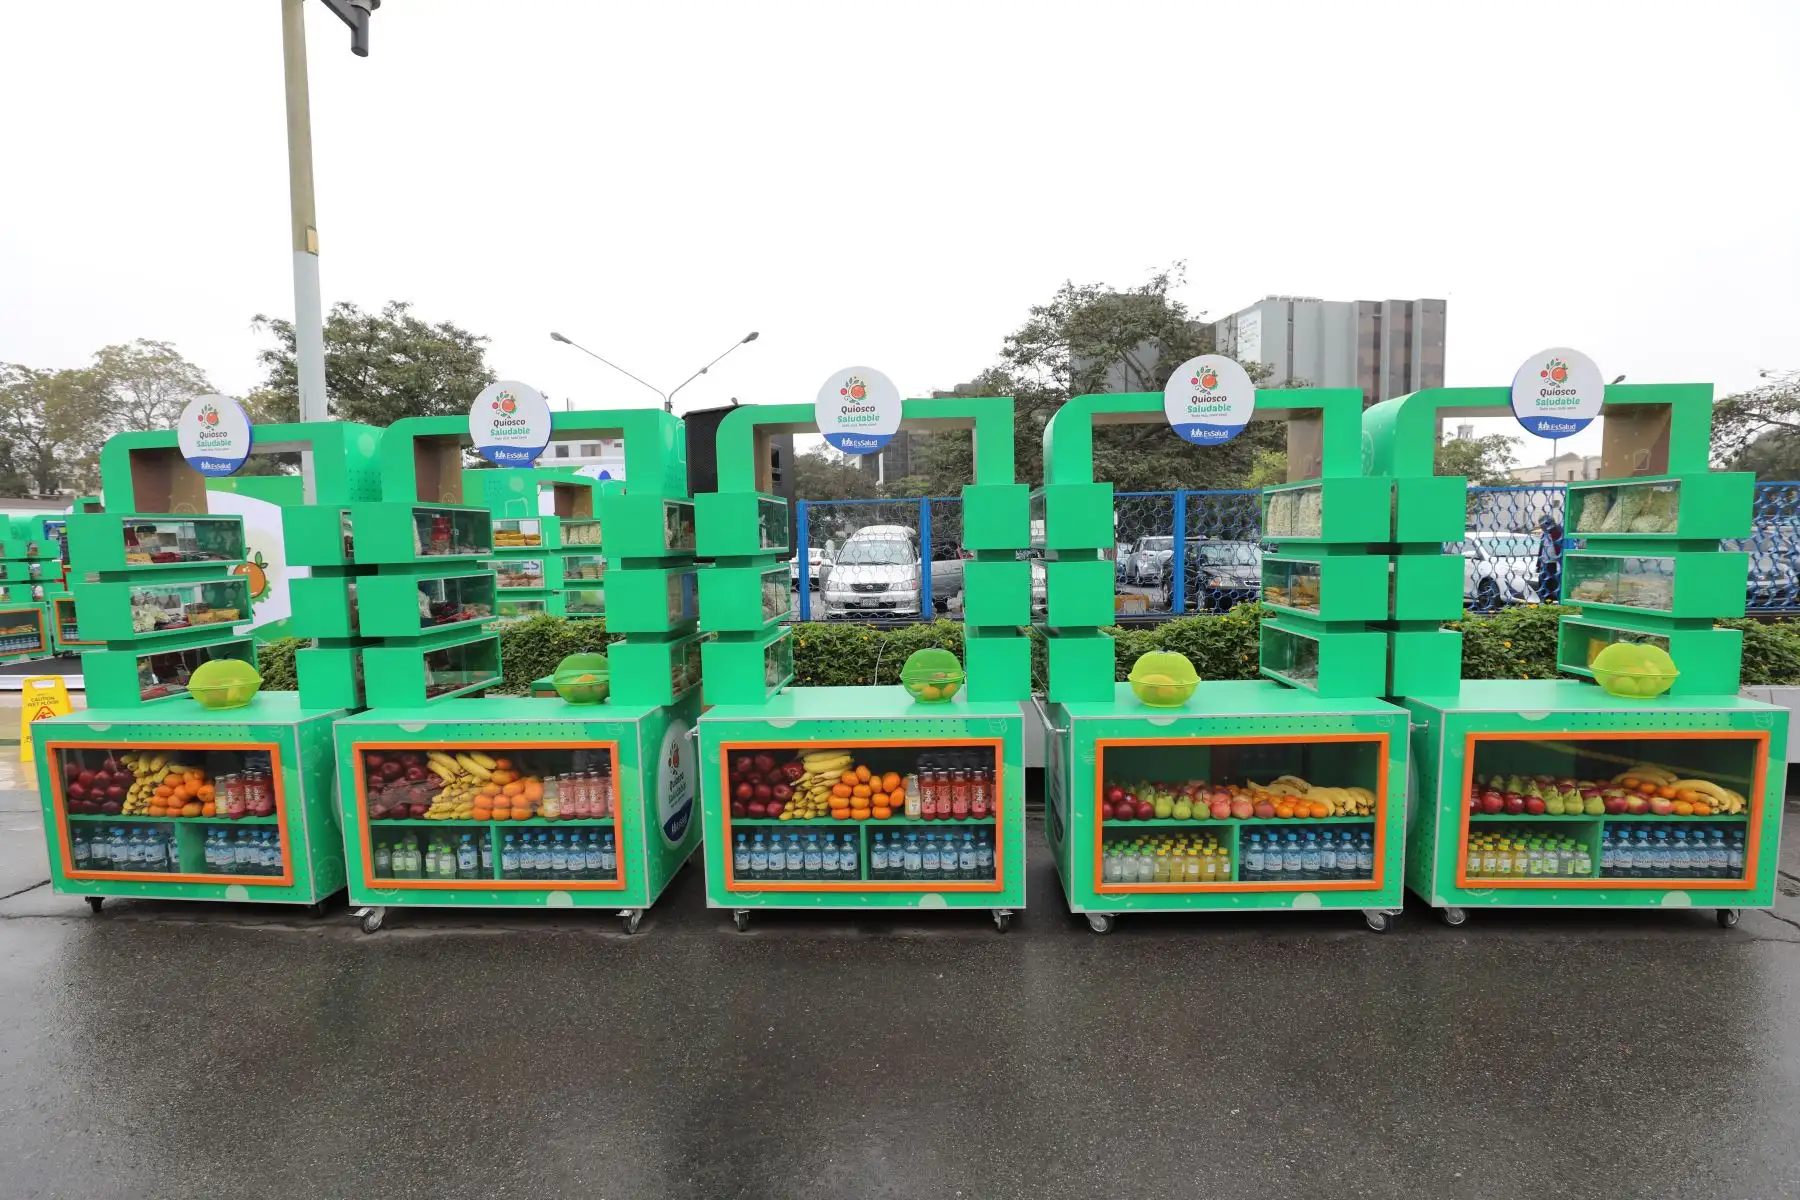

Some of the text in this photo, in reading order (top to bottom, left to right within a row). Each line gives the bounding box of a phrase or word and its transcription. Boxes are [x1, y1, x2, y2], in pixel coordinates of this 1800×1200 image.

[1540, 387, 1577, 398] Quiosco
[1191, 394, 1227, 404] Quiosco
[1535, 397, 1581, 406] Saludable
[841, 404, 876, 414] Quiosco
[1187, 404, 1232, 413] Saludable
[493, 418, 526, 428] Quiosco
[837, 414, 880, 423] Saludable
[199, 431, 228, 439] Quiosco
[490, 427, 531, 436] Saludable
[196, 440, 232, 448] Saludable
